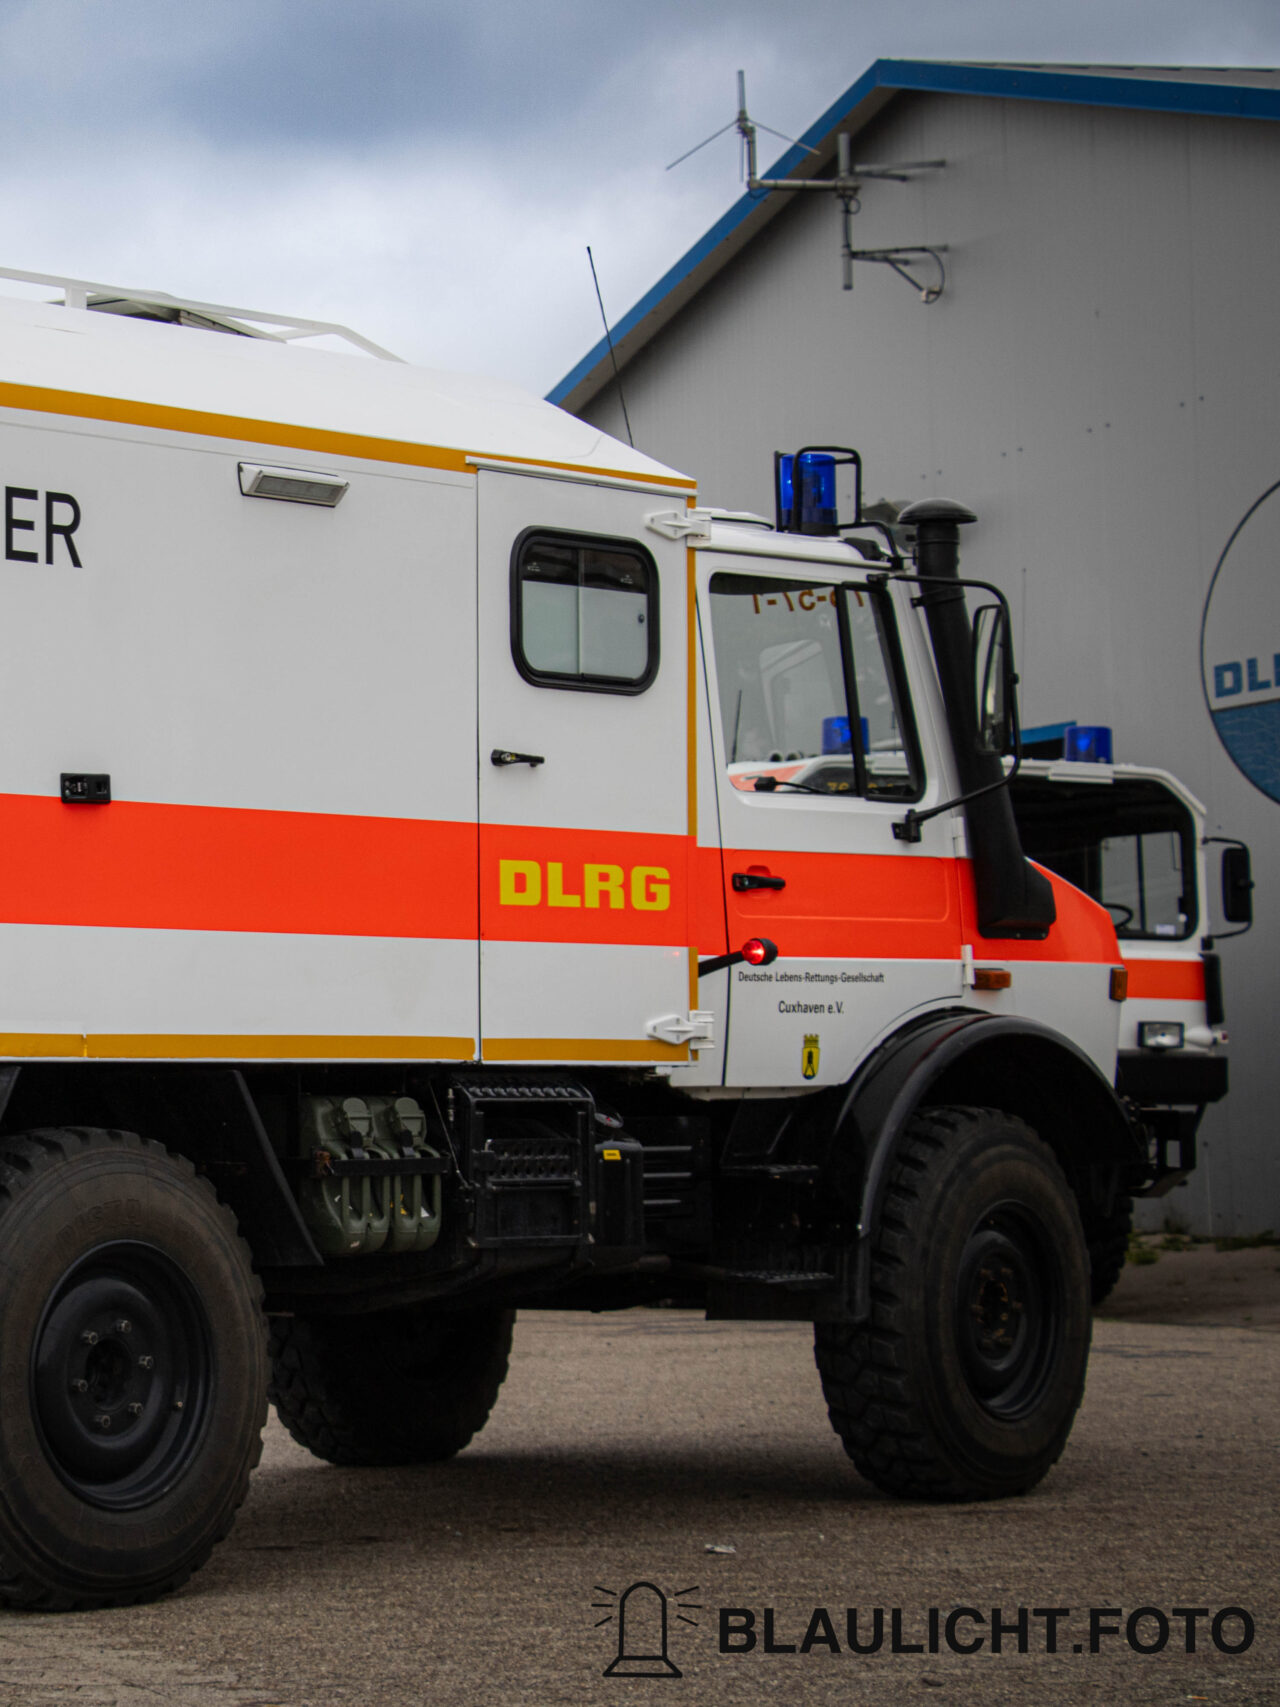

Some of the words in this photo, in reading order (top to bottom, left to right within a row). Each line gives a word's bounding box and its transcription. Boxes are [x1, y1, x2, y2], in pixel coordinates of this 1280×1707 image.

[499, 859, 671, 912] DLRG
[738, 971, 773, 982] Deutsche
[775, 971, 885, 985] Lebens-Rettungs-Gesellschaft
[778, 1000, 825, 1014] Cuxhaven
[827, 1001, 845, 1014] e.V.
